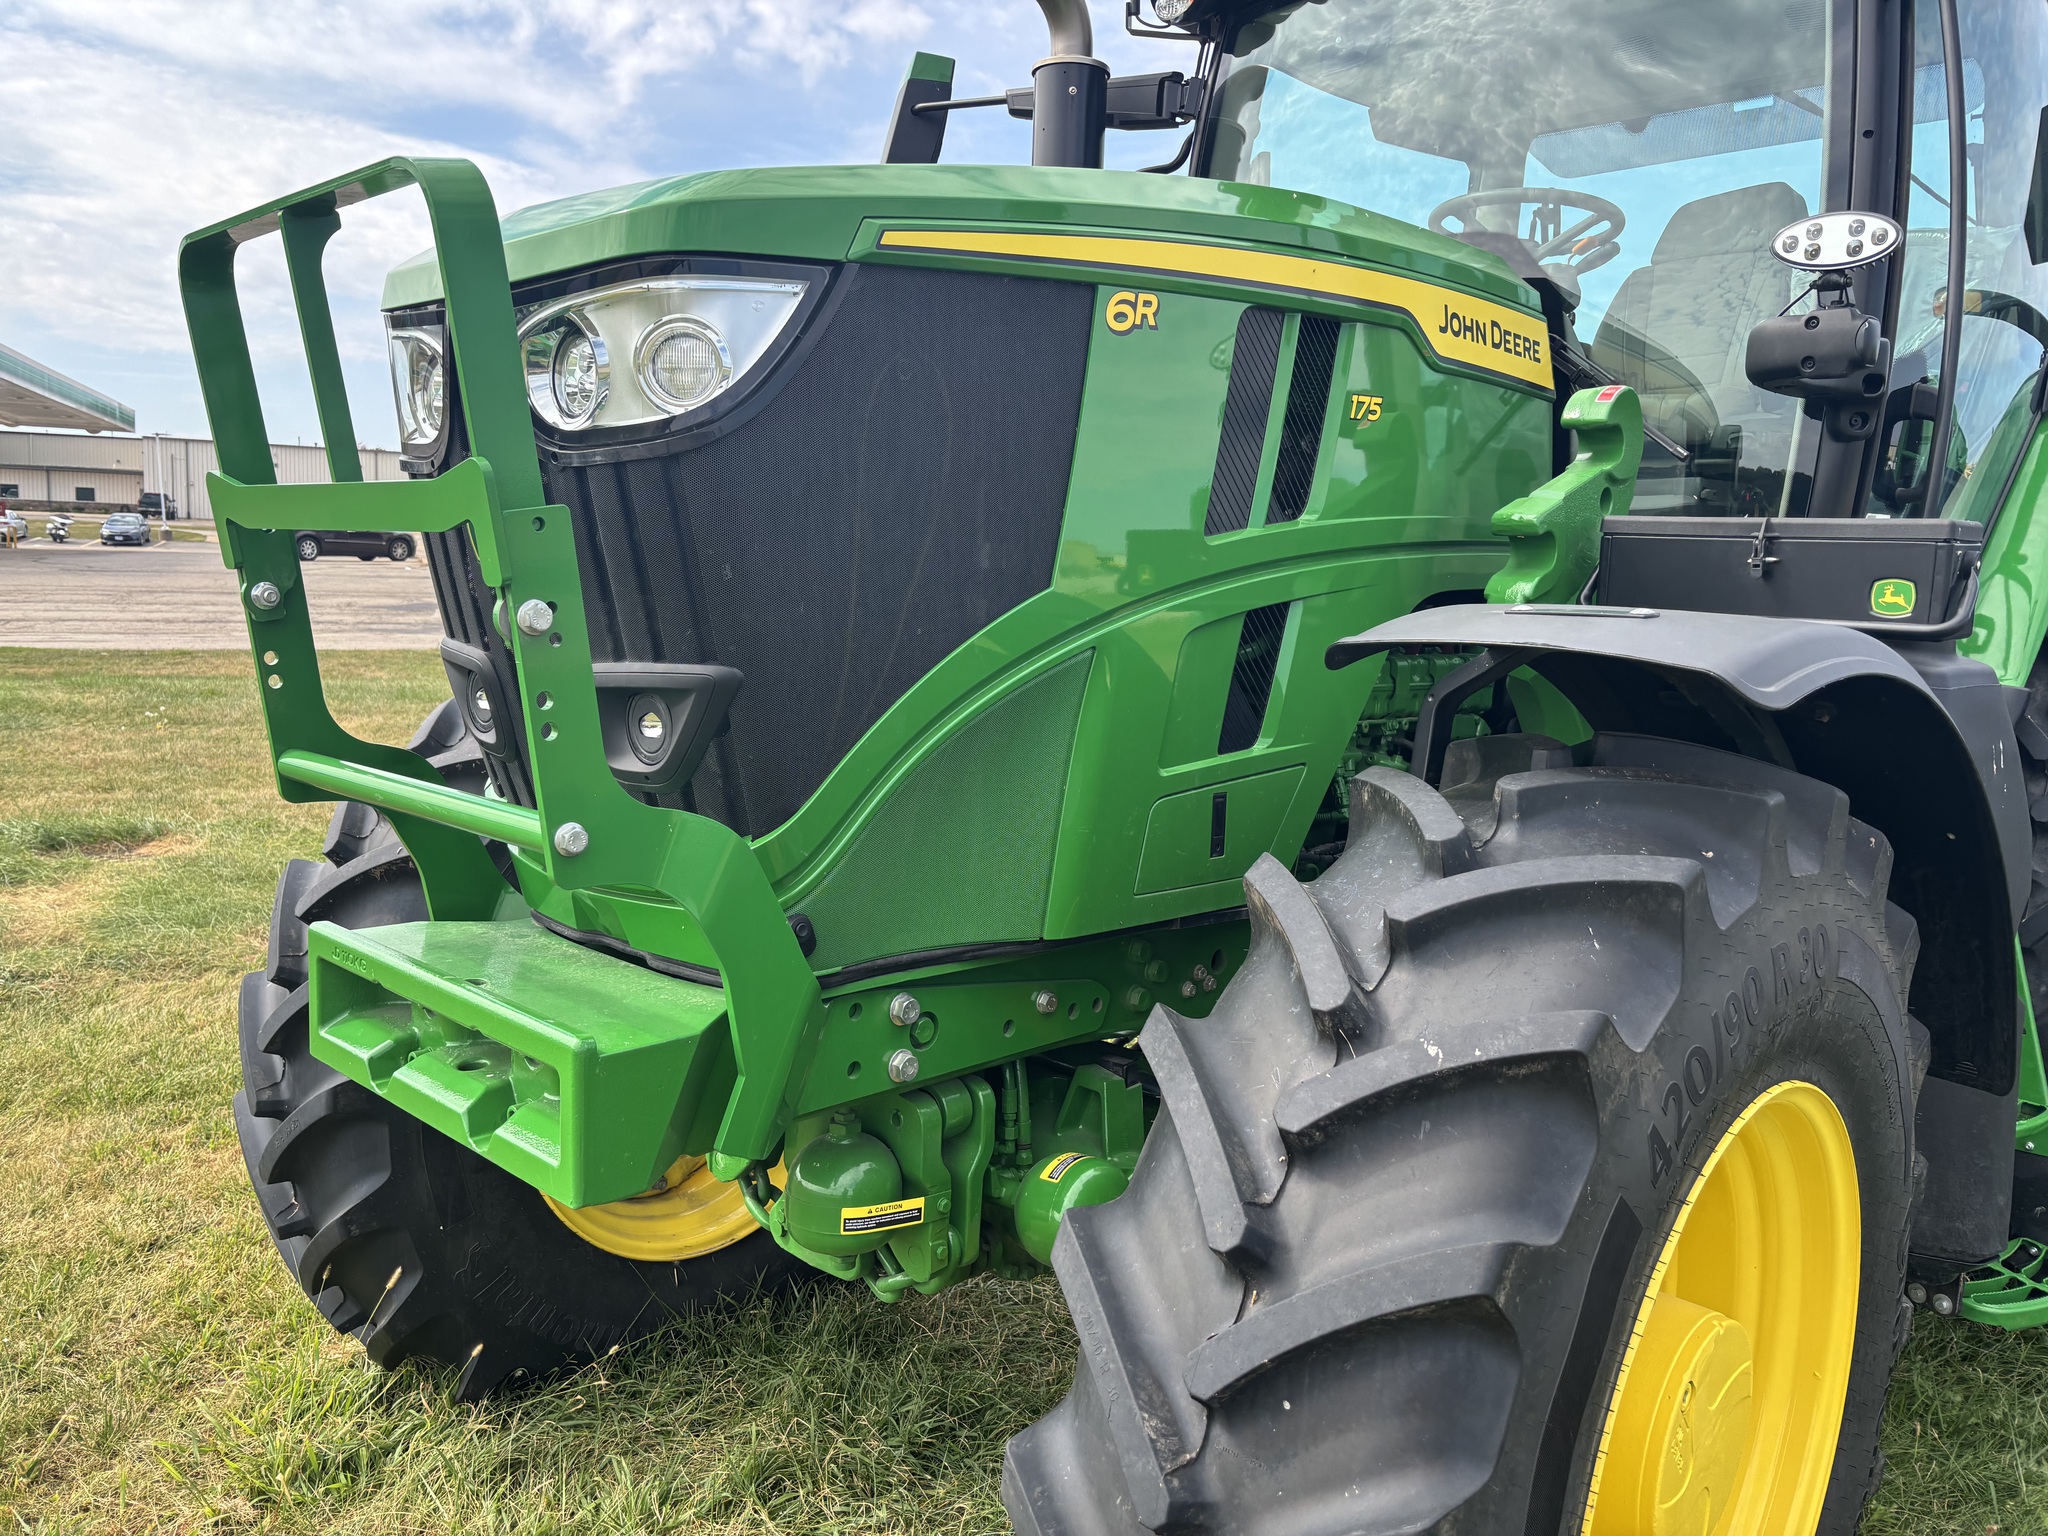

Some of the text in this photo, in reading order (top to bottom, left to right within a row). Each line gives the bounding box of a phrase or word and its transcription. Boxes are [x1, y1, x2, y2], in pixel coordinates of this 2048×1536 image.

[1105, 290, 1160, 337] 6R
[1438, 304, 1543, 365] JOHN DEERE
[1349, 394, 1384, 423] 175
[1647, 964, 1765, 1189] 420/90
[1770, 941, 1793, 1004] R
[1797, 924, 1831, 984] 30
[874, 1203, 903, 1213] CAUTION
